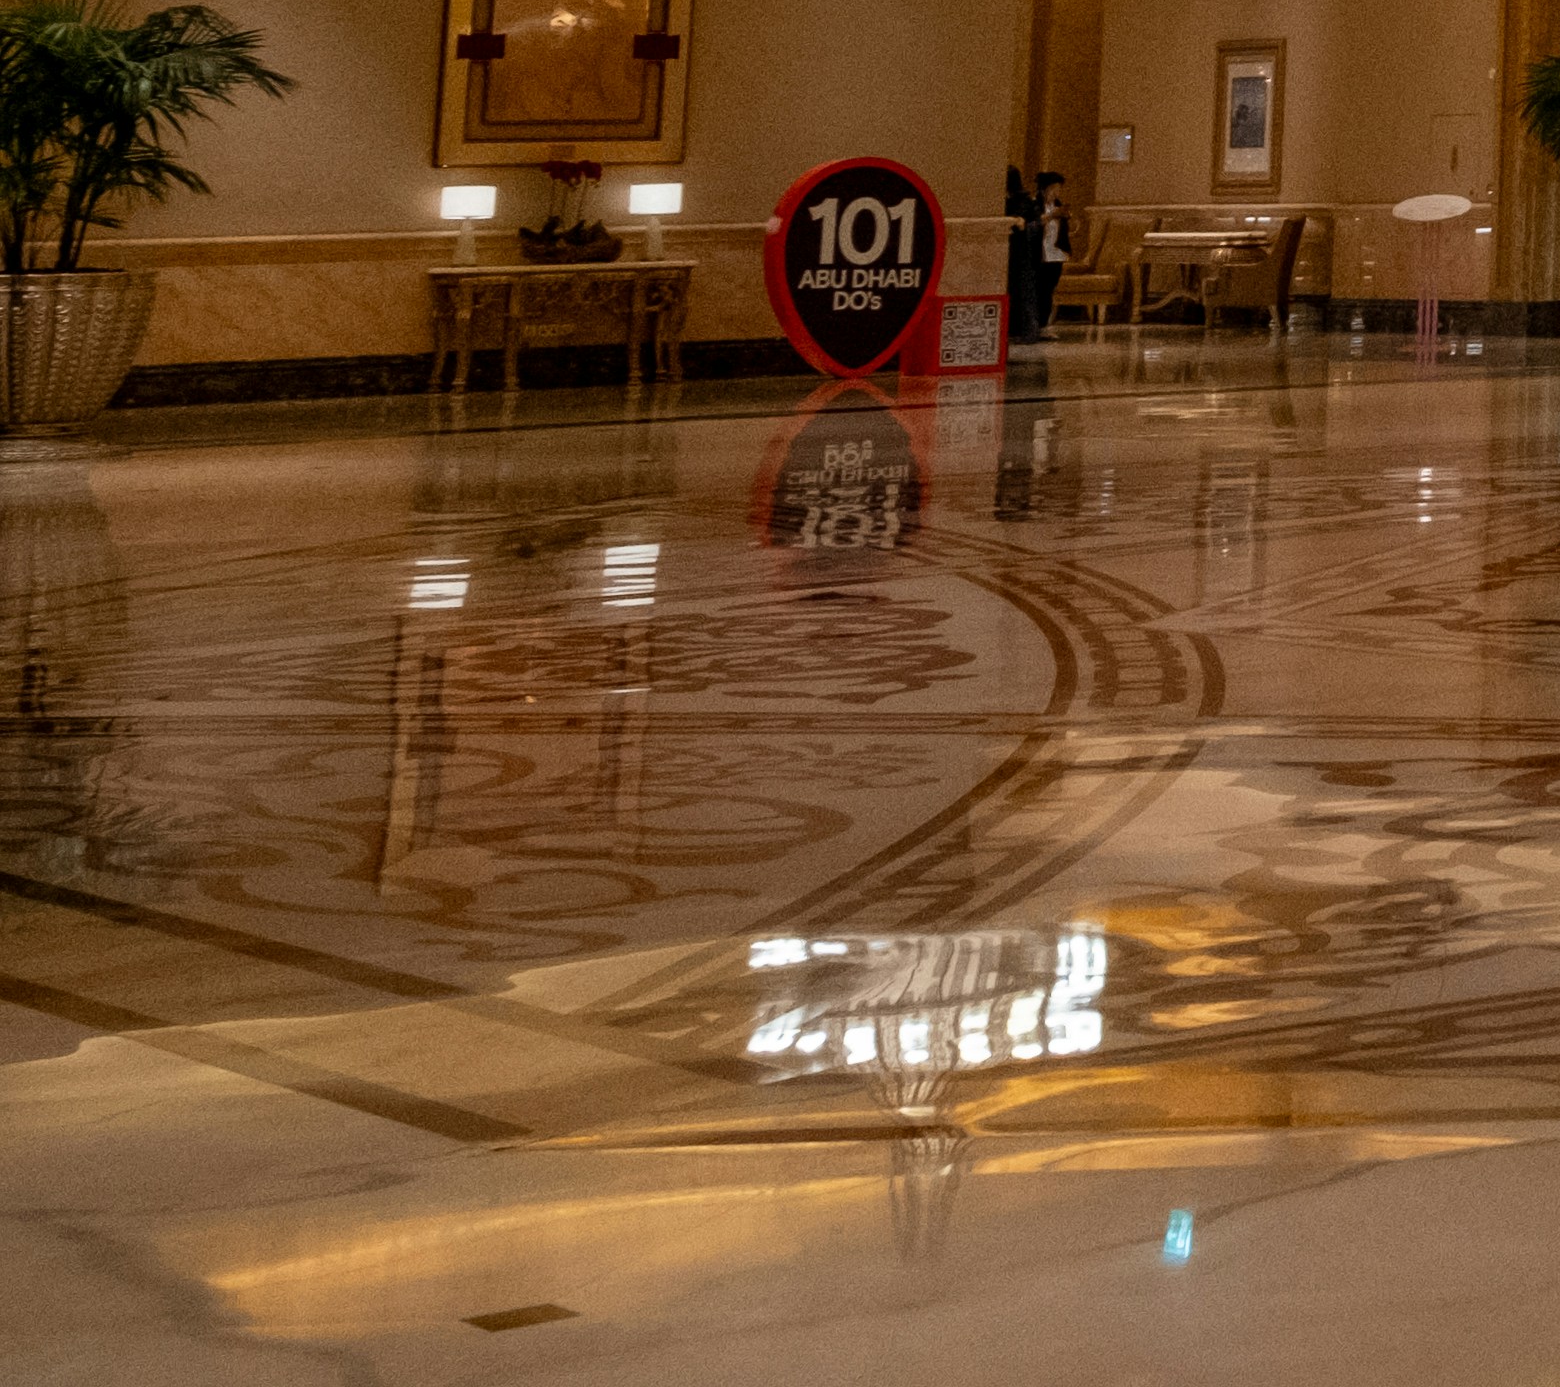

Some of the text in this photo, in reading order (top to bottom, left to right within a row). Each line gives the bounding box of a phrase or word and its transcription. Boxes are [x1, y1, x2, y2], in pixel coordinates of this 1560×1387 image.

[808, 196, 917, 266] 101
[797, 268, 922, 289] ABU DHABI
[832, 290, 883, 311] DO's
